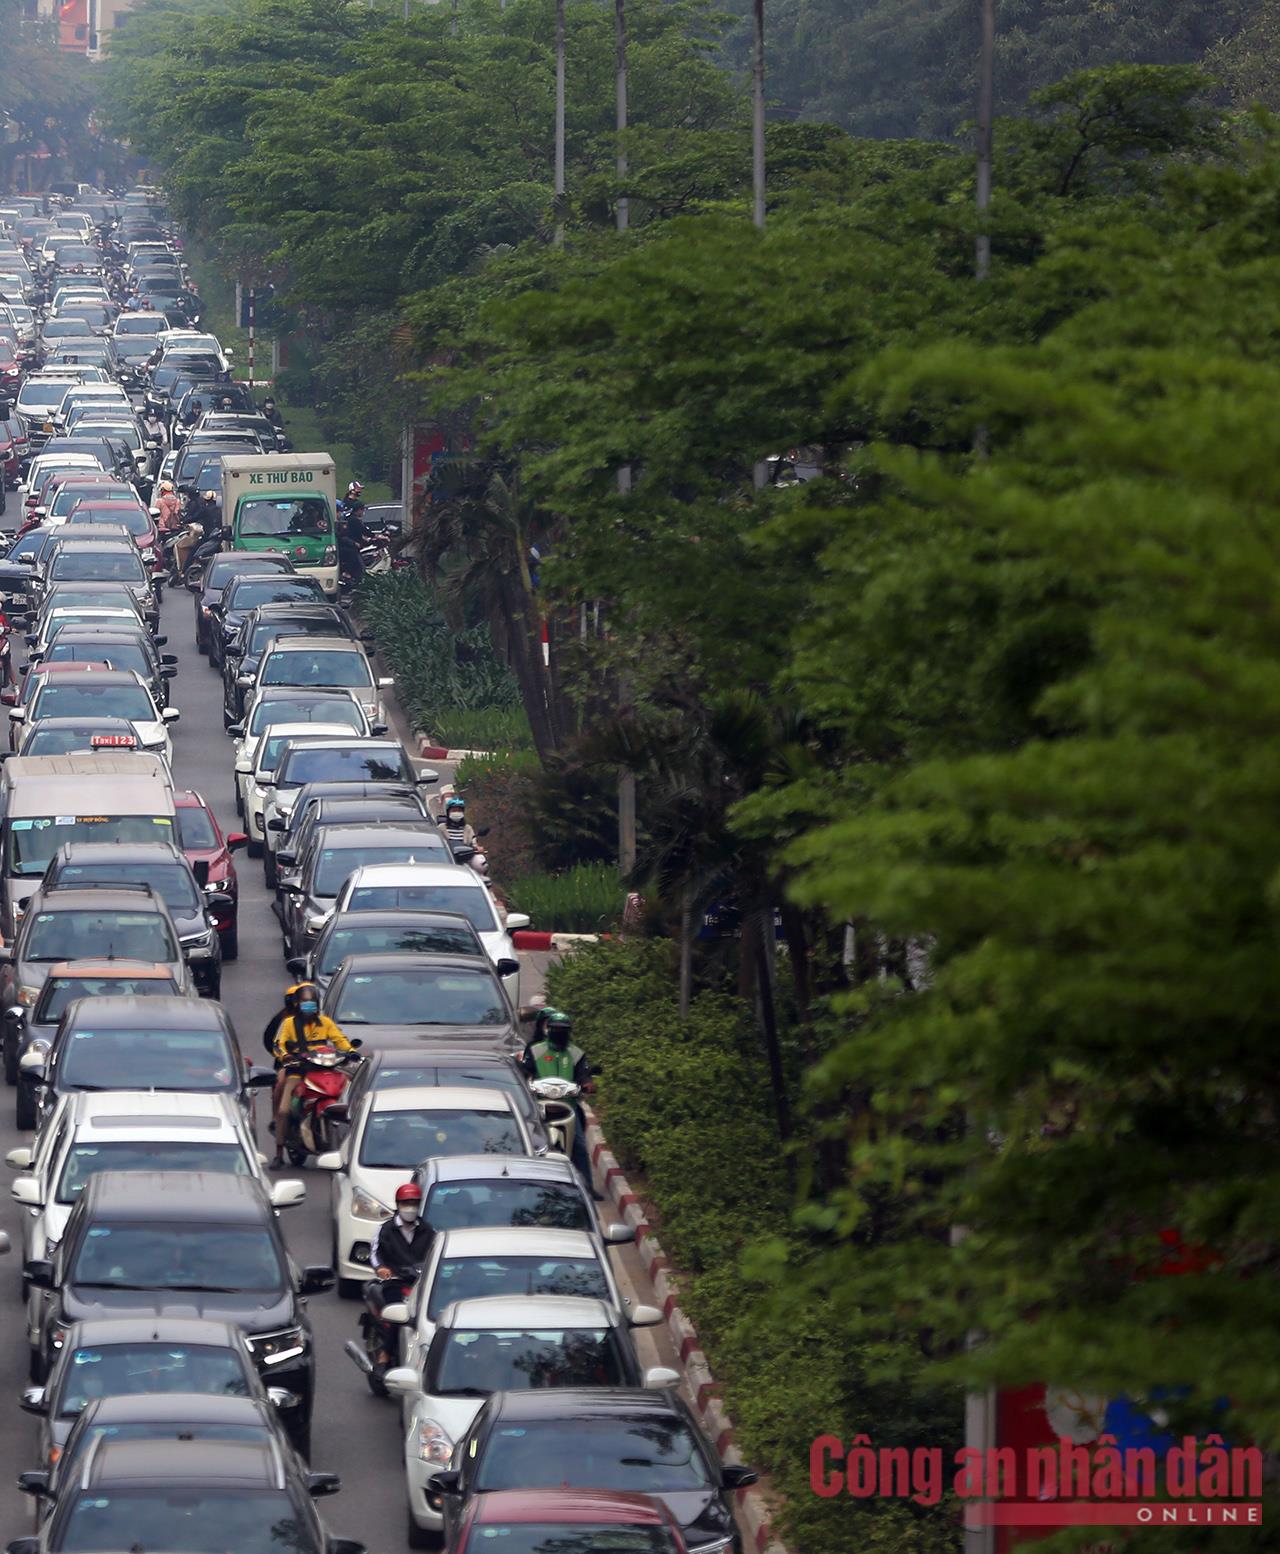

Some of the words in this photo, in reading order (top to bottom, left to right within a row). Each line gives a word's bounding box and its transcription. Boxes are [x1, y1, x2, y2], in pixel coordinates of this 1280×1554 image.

[249, 473, 263, 484] XE
[95, 735, 113, 745] Taxi
[114, 735, 134, 745] 123
